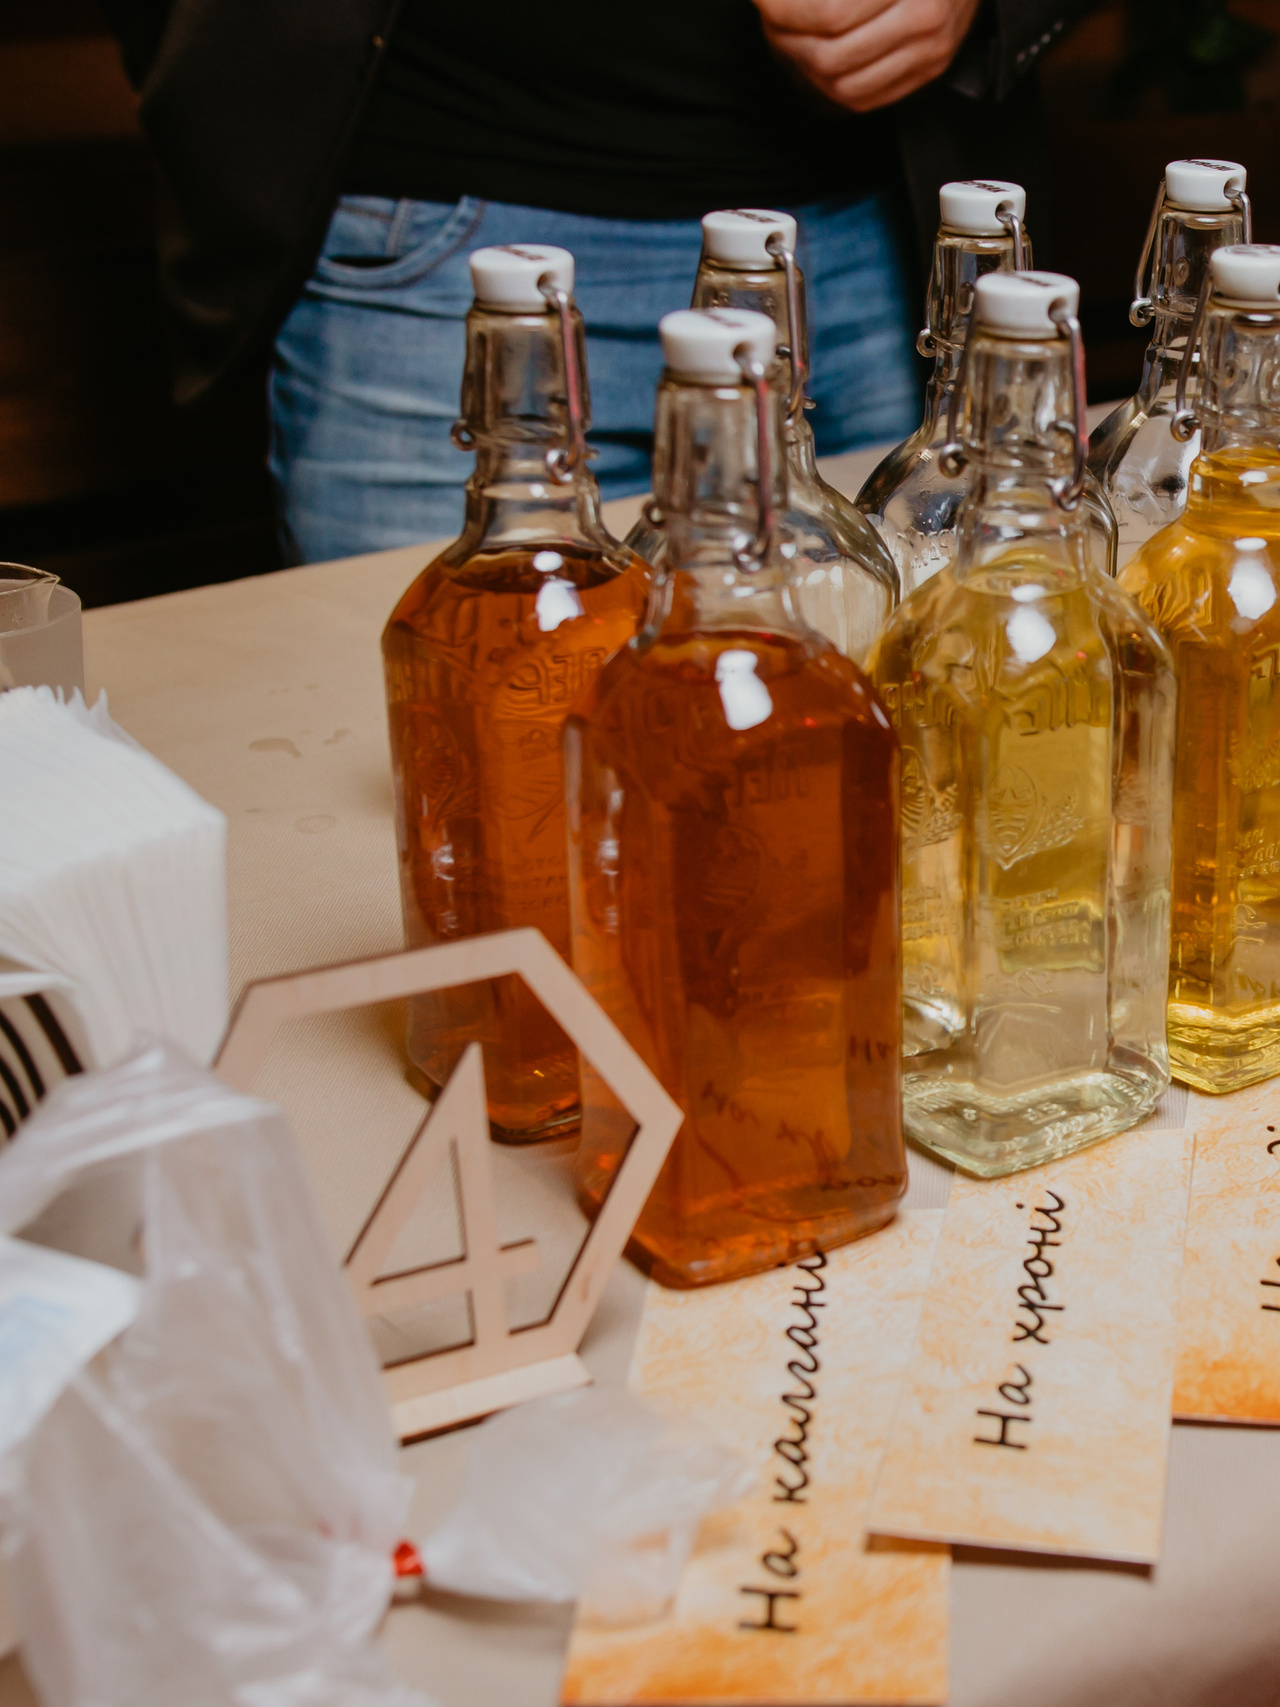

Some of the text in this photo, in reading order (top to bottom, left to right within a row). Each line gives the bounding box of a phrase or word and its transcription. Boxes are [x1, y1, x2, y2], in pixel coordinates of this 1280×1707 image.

[343, 1041, 540, 1345] 4
[973, 1190, 1067, 1451] На хроні
[739, 1527, 802, 1635] На
